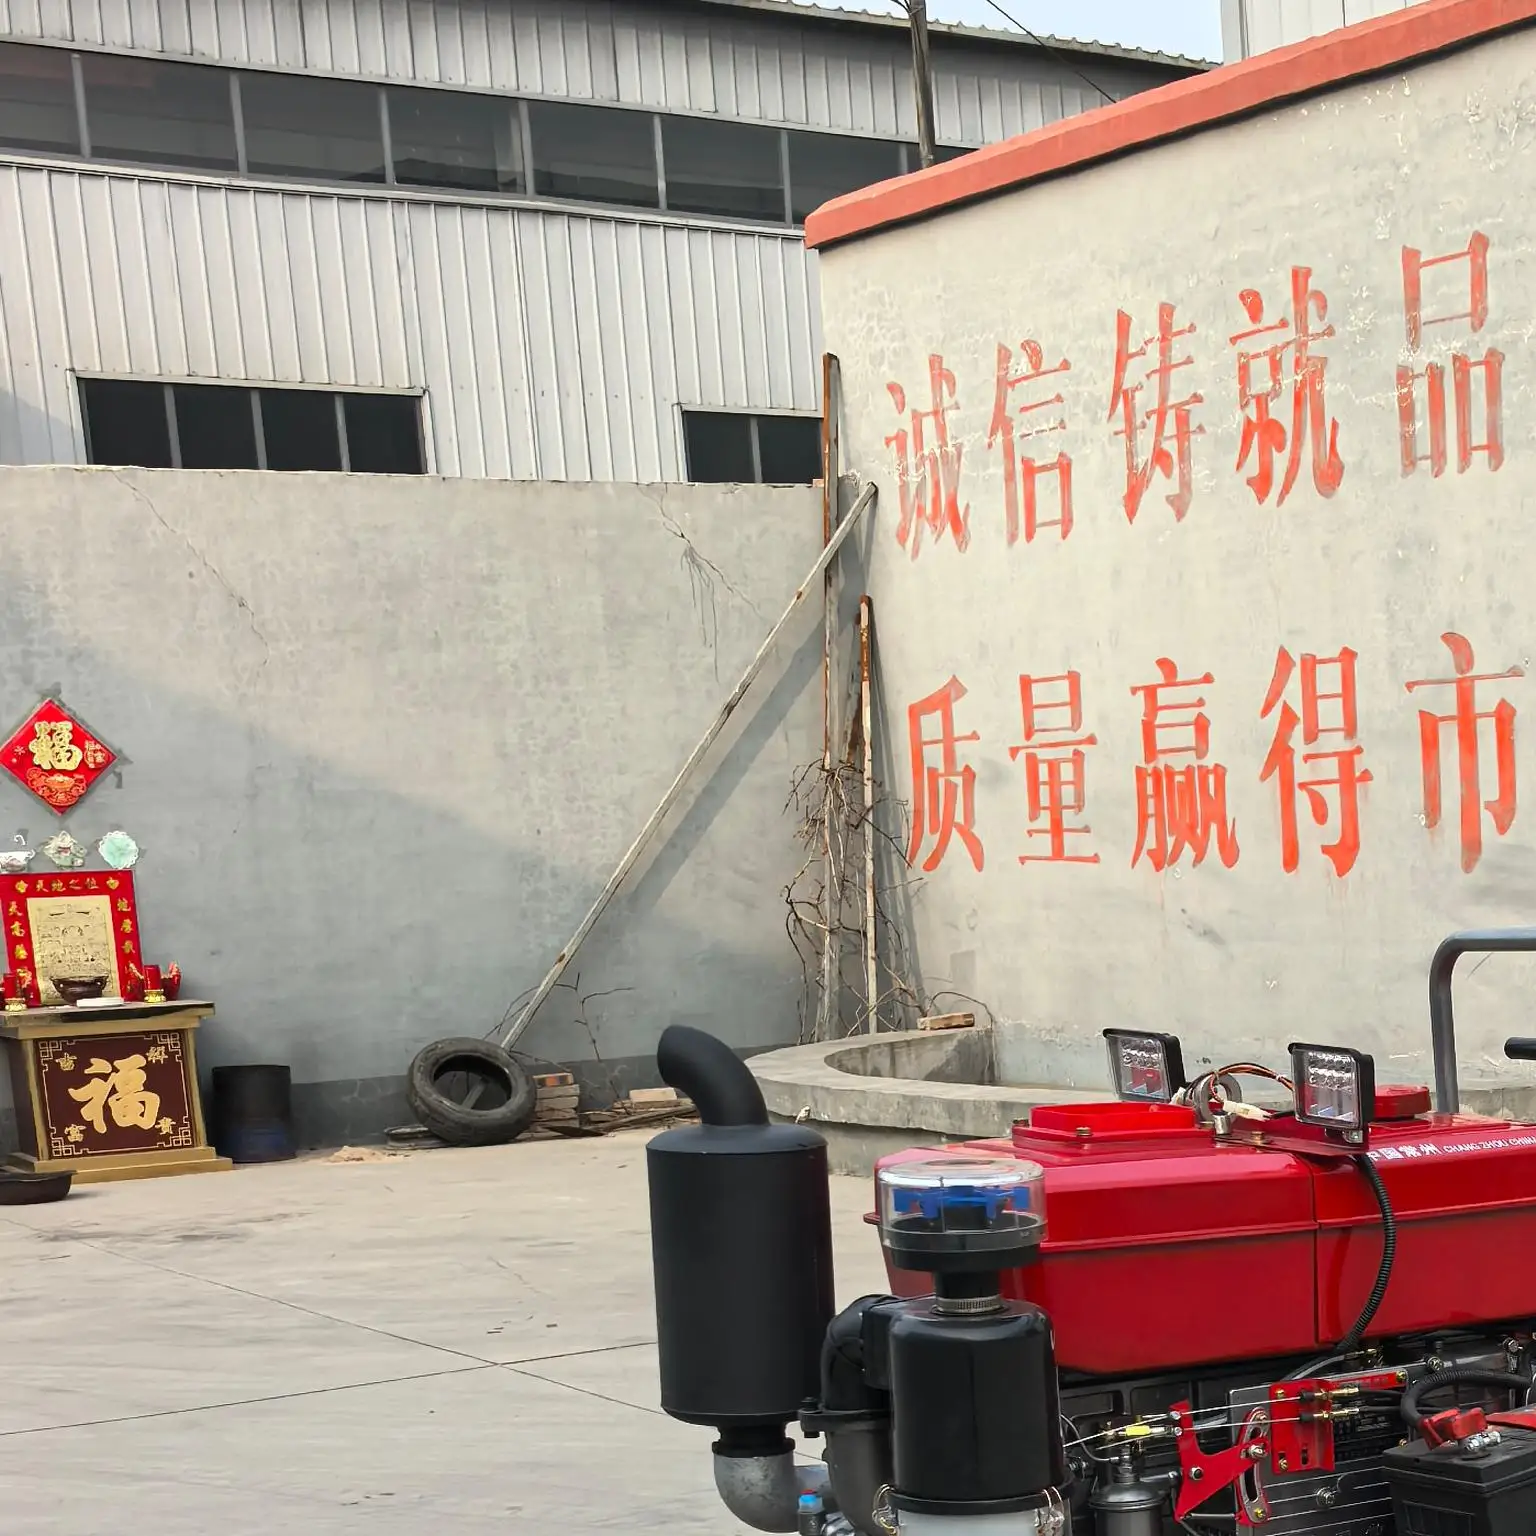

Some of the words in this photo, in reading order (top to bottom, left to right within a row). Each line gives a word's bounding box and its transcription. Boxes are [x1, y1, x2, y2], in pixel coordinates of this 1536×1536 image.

[29, 721, 83, 770] 福
[68, 1054, 160, 1134] 福
[1443, 1143, 1479, 1153] CHANG
[1479, 1138, 1509, 1149] ZHOU
